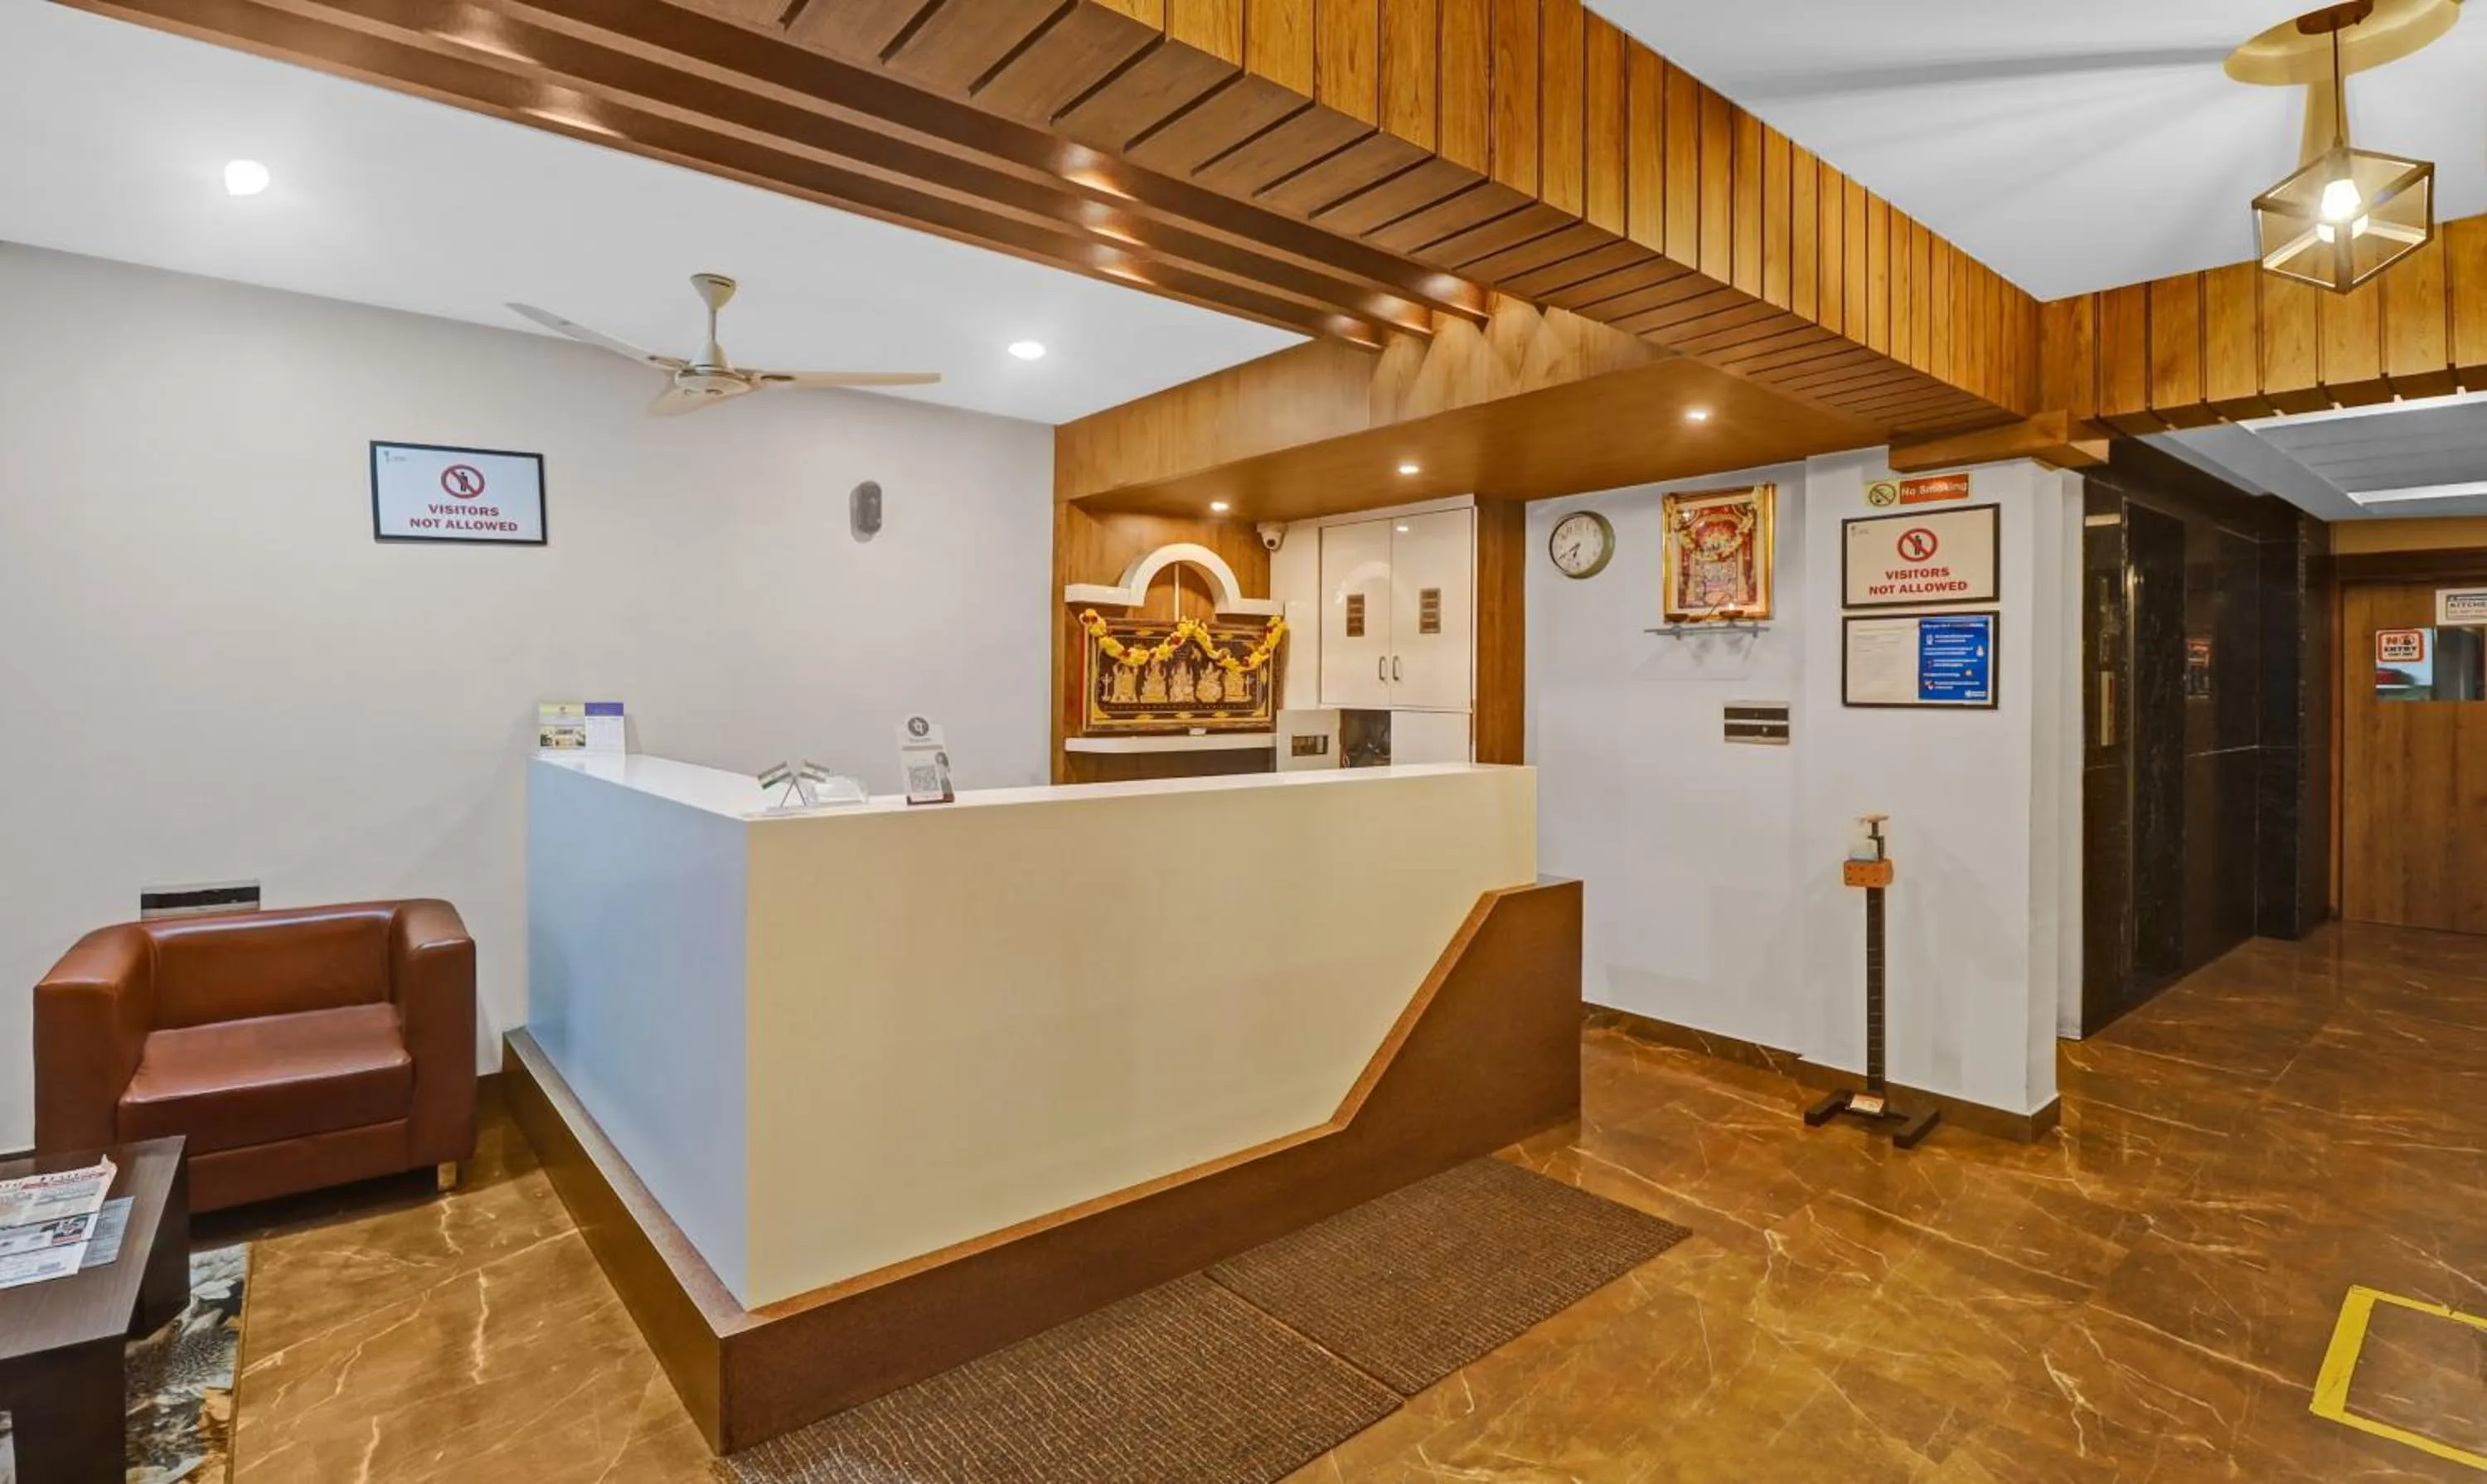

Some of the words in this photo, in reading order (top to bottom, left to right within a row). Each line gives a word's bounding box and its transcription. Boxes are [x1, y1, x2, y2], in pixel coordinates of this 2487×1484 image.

[428, 503, 500, 516] VISITORS
[410, 518, 442, 528] NOT
[445, 519, 518, 531] ALLOWED
[1885, 567, 1950, 580] VISITORS
[1869, 584, 1896, 594] NOT
[1899, 581, 1967, 594] ALLOWED
